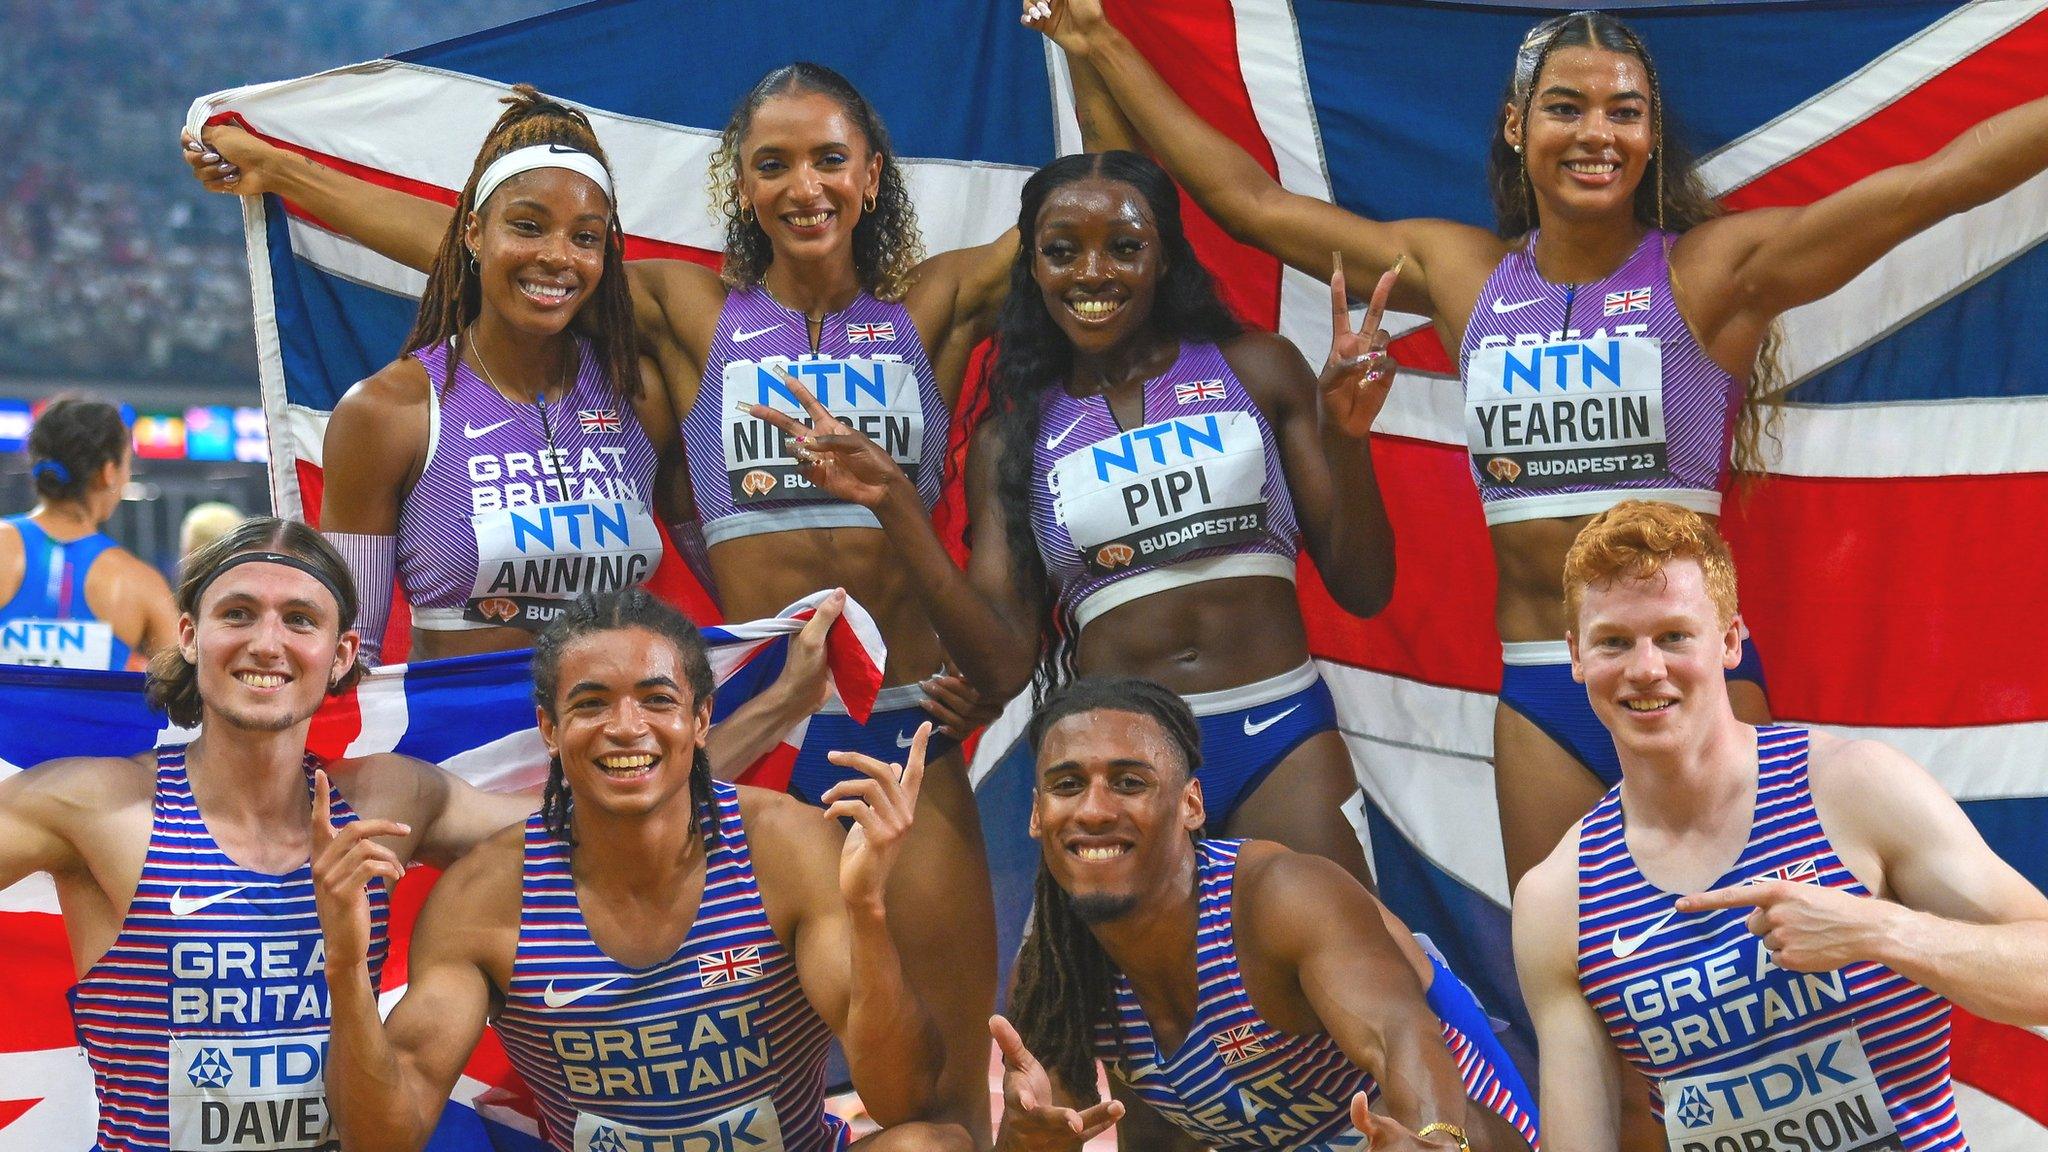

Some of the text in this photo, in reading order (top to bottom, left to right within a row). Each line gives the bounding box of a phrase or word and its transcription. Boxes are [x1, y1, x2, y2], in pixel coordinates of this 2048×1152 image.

[757, 363, 887, 408] NTN
[1502, 341, 1621, 395] NTN
[1475, 395, 1651, 448] YEARGIN
[467, 447, 626, 482] GREAT
[1092, 415, 1224, 483] NTN
[1526, 453, 1656, 476] BUDAPEST 23
[471, 477, 639, 516] BRITAIN
[1121, 466, 1212, 526] PIPI
[510, 503, 630, 554] NTN
[1139, 513, 1258, 555] BUDAPEST 23
[487, 553, 648, 593] ANNING
[3, 624, 85, 652] NTN
[172, 939, 325, 979] GREA
[1623, 939, 1788, 1023] GREA
[173, 984, 332, 1024] BRITA
[1639, 968, 1847, 1066] BRITAIN
[553, 1001, 762, 1062] GREAT
[232, 1043, 328, 1088] TD
[563, 1037, 769, 1096] BRITAIN
[1706, 1040, 1858, 1121] TDK
[201, 1097, 332, 1145] DAVE
